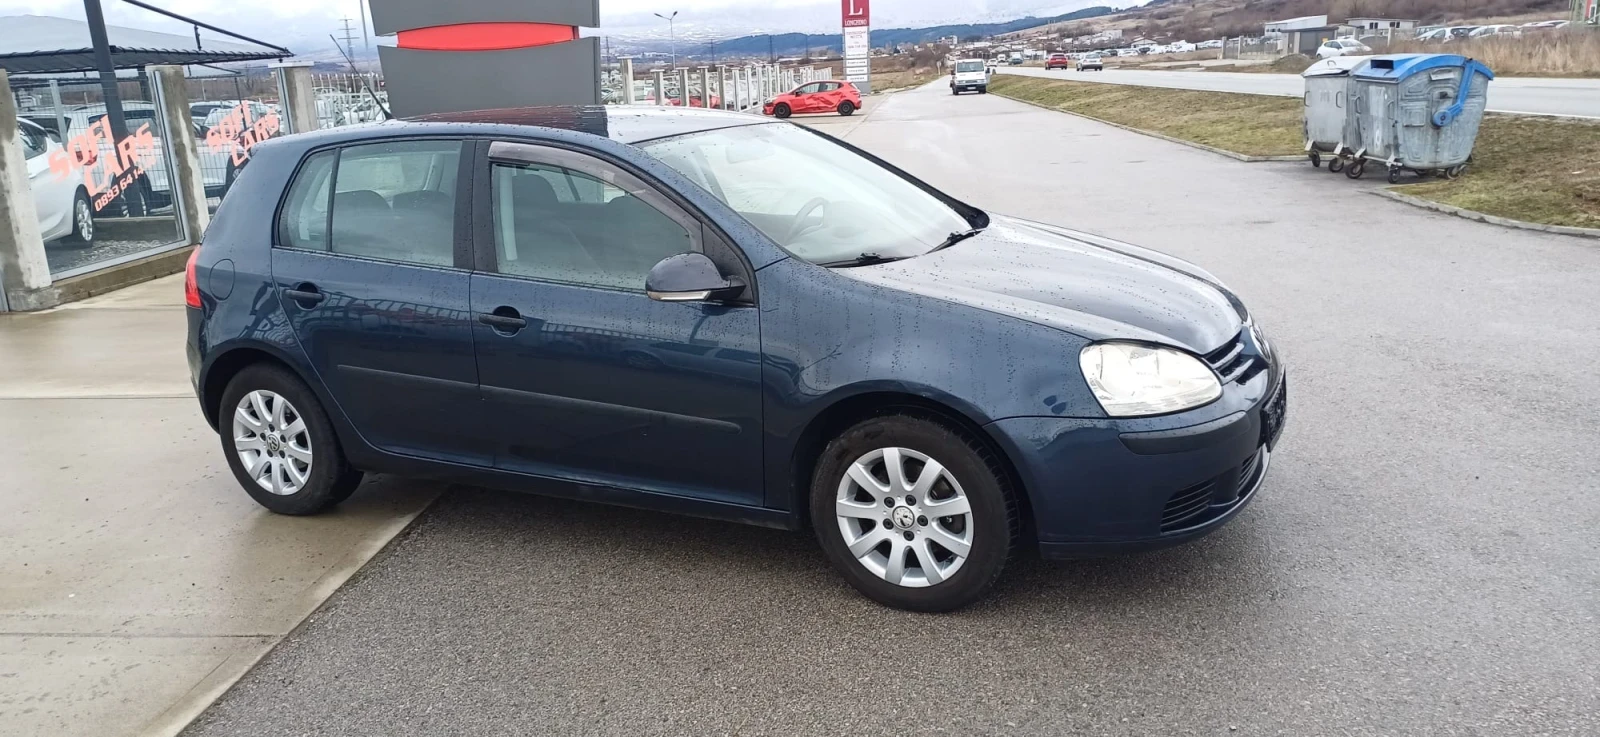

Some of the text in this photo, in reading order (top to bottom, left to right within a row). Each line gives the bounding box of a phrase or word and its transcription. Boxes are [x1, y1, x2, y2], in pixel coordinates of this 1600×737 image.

[848, 0, 863, 16] L
[48, 115, 115, 181] SOFI
[206, 100, 253, 154] SOFI
[230, 108, 280, 167] CARS
[84, 122, 156, 197] CARS
[94, 185, 120, 212] 0893
[119, 173, 133, 190] 64
